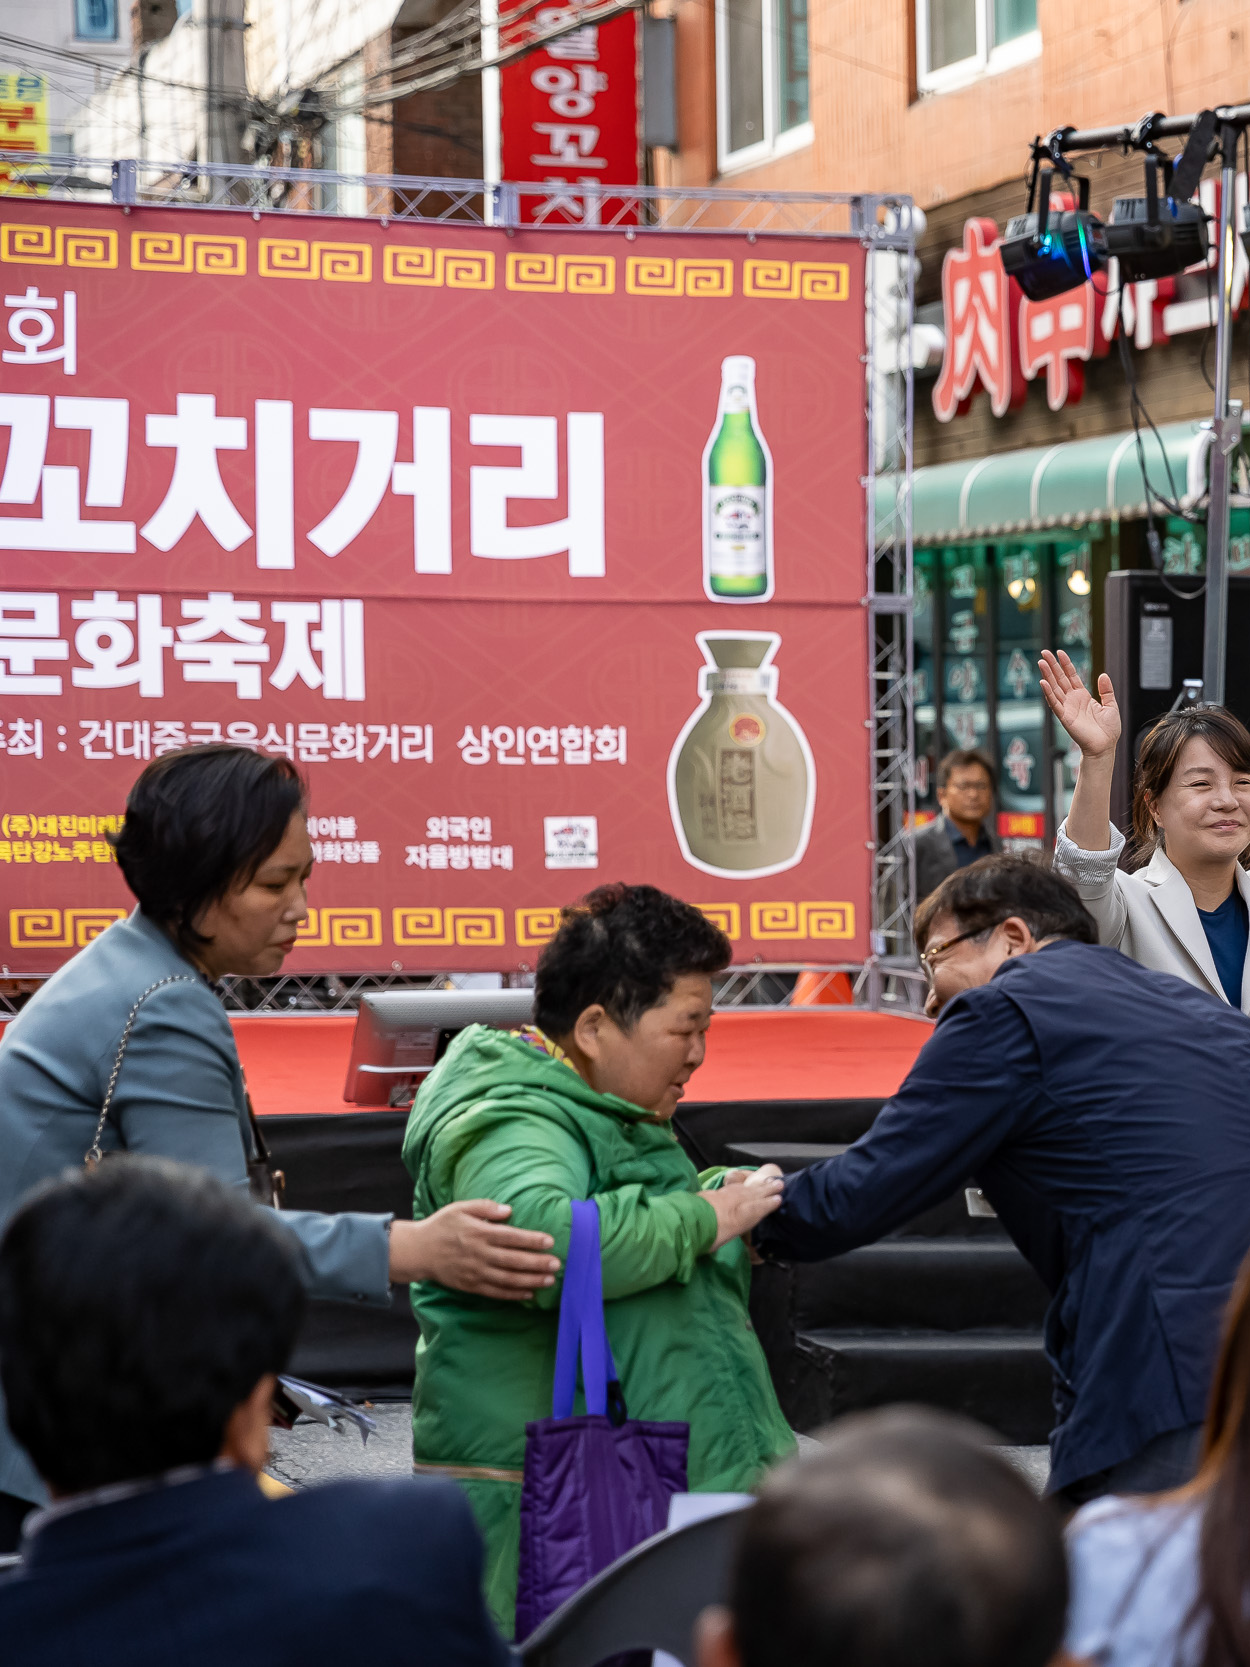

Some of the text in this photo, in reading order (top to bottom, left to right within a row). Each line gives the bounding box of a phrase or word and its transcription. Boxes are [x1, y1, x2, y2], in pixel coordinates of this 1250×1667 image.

[2, 286, 77, 376] 회
[0, 393, 607, 578] 꼬치거리
[0, 590, 367, 701] 문화축제
[0, 717, 44, 761] 최
[456, 723, 628, 766] 상인연합회
[404, 843, 514, 871] 자율방범대
[425, 815, 493, 842] 외국인
